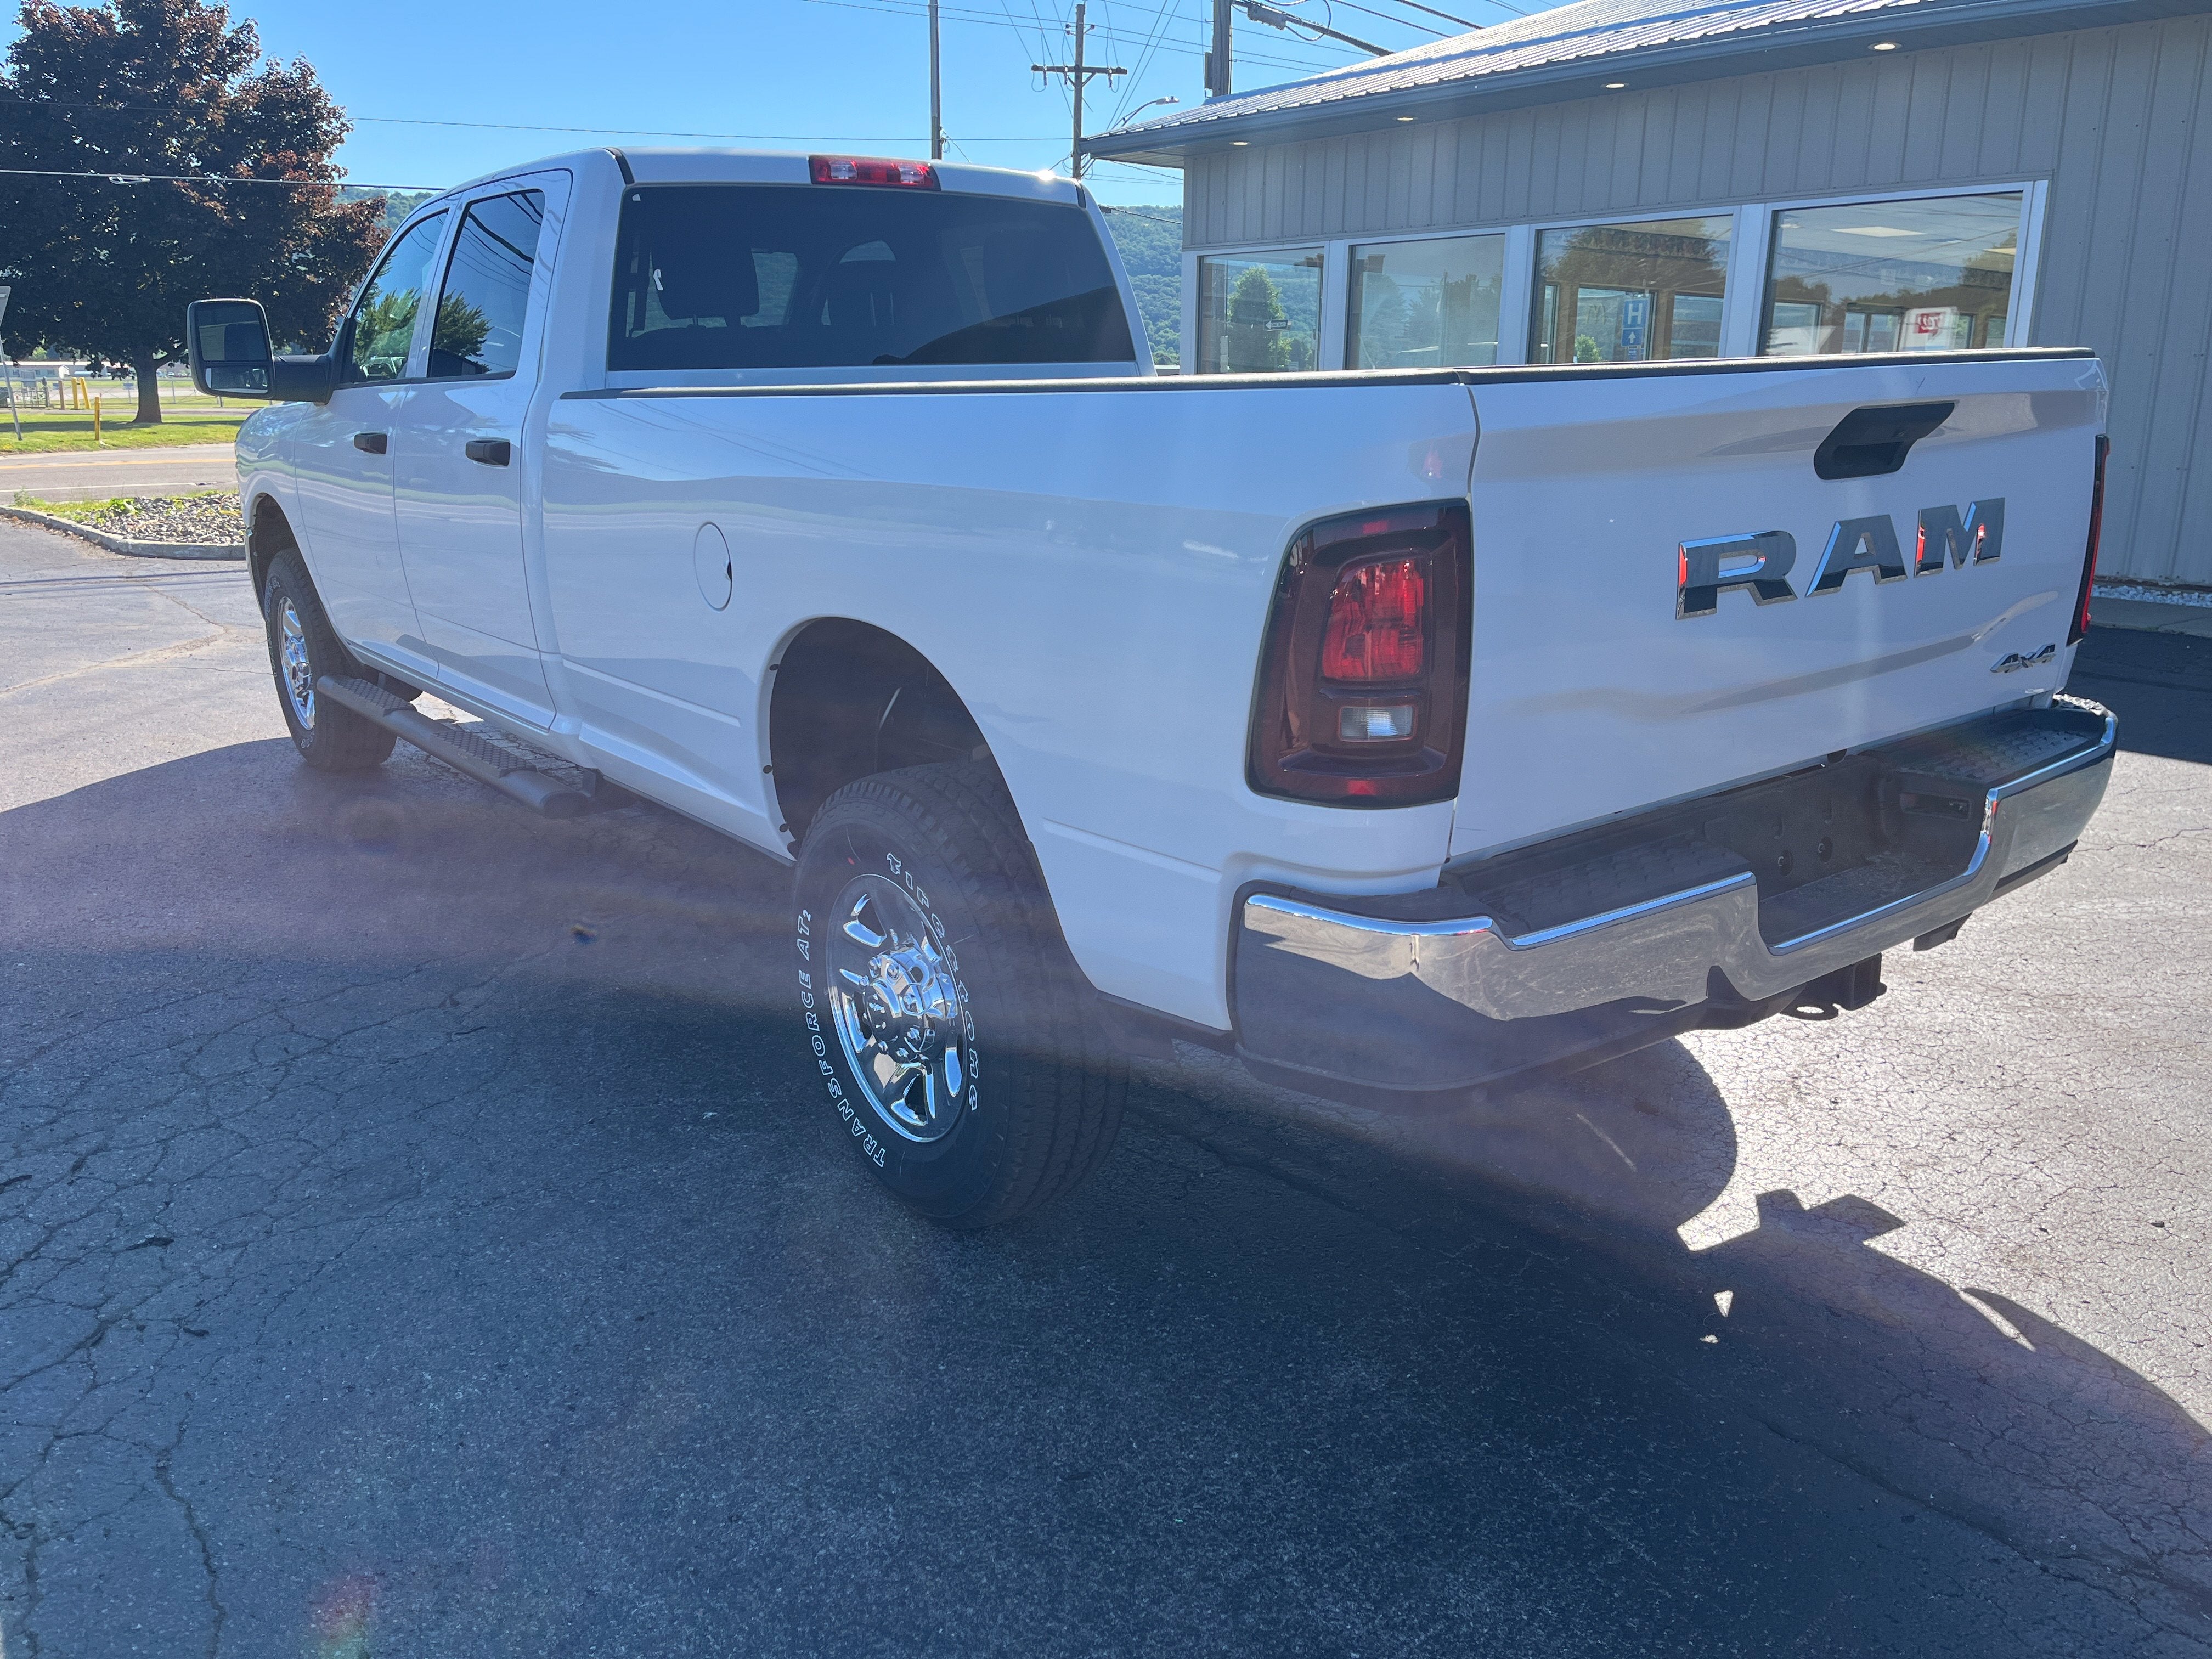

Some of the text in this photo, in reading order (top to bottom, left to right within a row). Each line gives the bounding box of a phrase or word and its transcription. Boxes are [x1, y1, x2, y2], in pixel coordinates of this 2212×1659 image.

[1627, 303, 1643, 325] H
[1675, 497, 2006, 620] RAM
[798, 968, 886, 1168] TRANSFORCE
